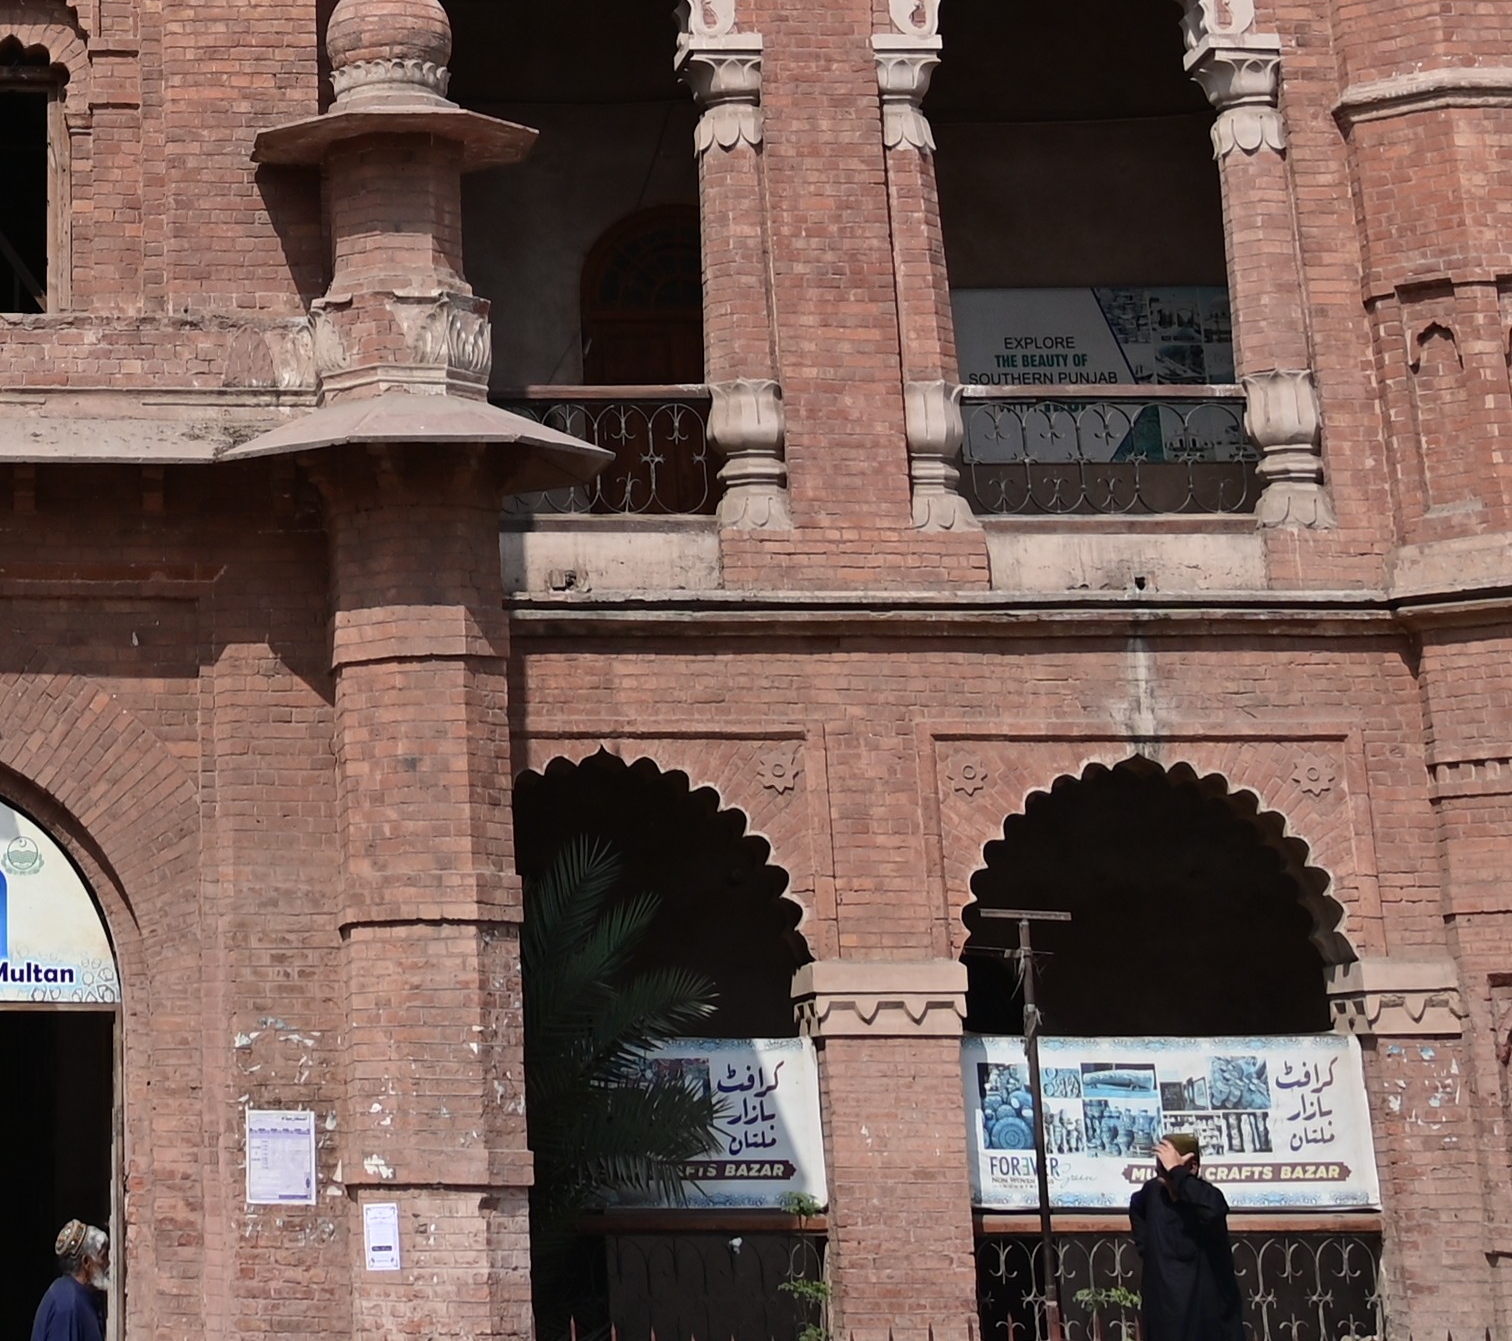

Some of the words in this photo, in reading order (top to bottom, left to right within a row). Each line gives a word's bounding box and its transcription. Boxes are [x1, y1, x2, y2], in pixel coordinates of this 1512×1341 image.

[1004, 336, 1075, 349] EXPLORE
[995, 354, 1017, 368] THE
[1022, 353, 1068, 367] BEAUTY
[1073, 353, 1088, 366] OF
[968, 373, 1053, 385] SOUTHERN
[1059, 372, 1118, 384] PUNJAB
[717, 1060, 784, 1097] کرافٹ
[1275, 1056, 1338, 1093] کرافٹ
[726, 1097, 776, 1130] بازار
[1287, 1093, 1334, 1125] بازار
[729, 1130, 777, 1155] ملتان
[1290, 1125, 1335, 1152] ملتان
[724, 1163, 784, 1177] BAZAR
[1205, 1166, 1273, 1181] CRAFTS
[1280, 1164, 1340, 1179] BAZAR
